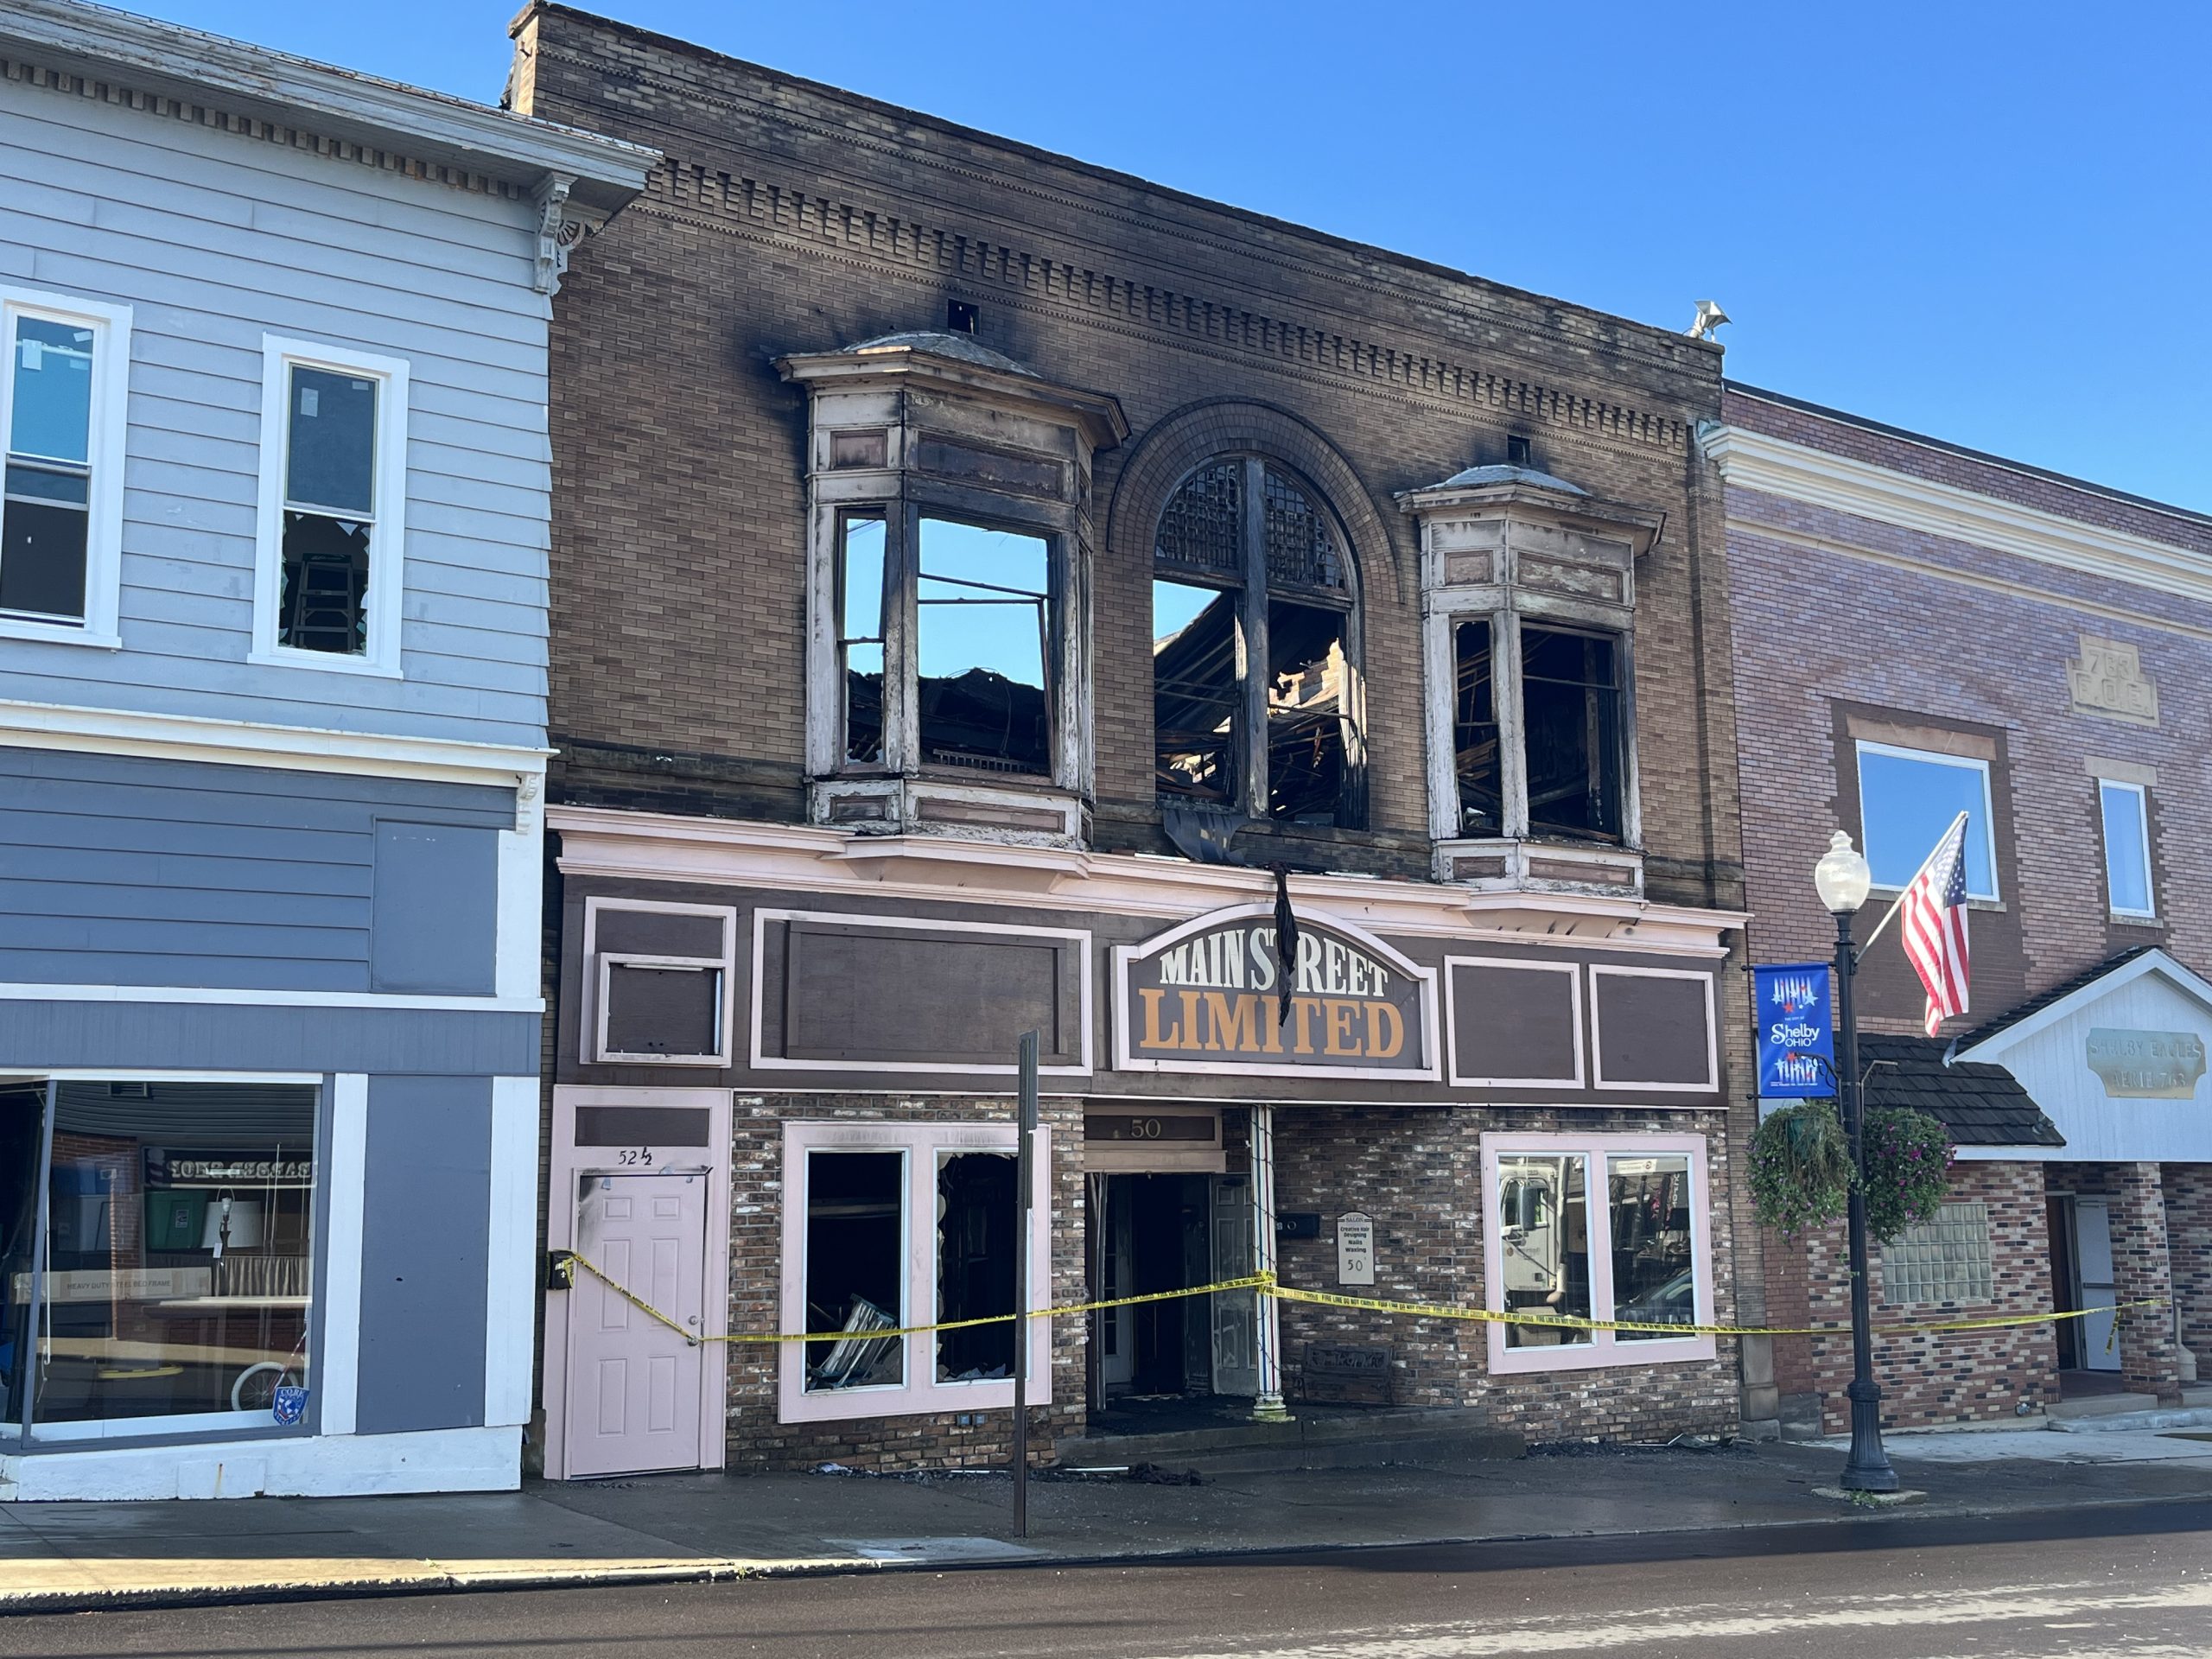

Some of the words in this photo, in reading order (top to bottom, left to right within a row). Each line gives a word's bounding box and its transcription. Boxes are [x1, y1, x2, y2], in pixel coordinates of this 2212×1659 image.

[2089, 650, 2130, 681] 763
[2075, 672, 2150, 714] F.O.E.
[1160, 928, 1245, 988] MAIN
[1139, 988, 1404, 1058] LIMITED
[1770, 1023, 1820, 1045] Shelby
[1784, 1038, 1812, 1047] OHIO
[2159, 1072, 2186, 1088] 763
[1131, 1118, 1161, 1138] 50
[618, 1150, 637, 1166] 52
[1347, 1259, 1363, 1272] 50
